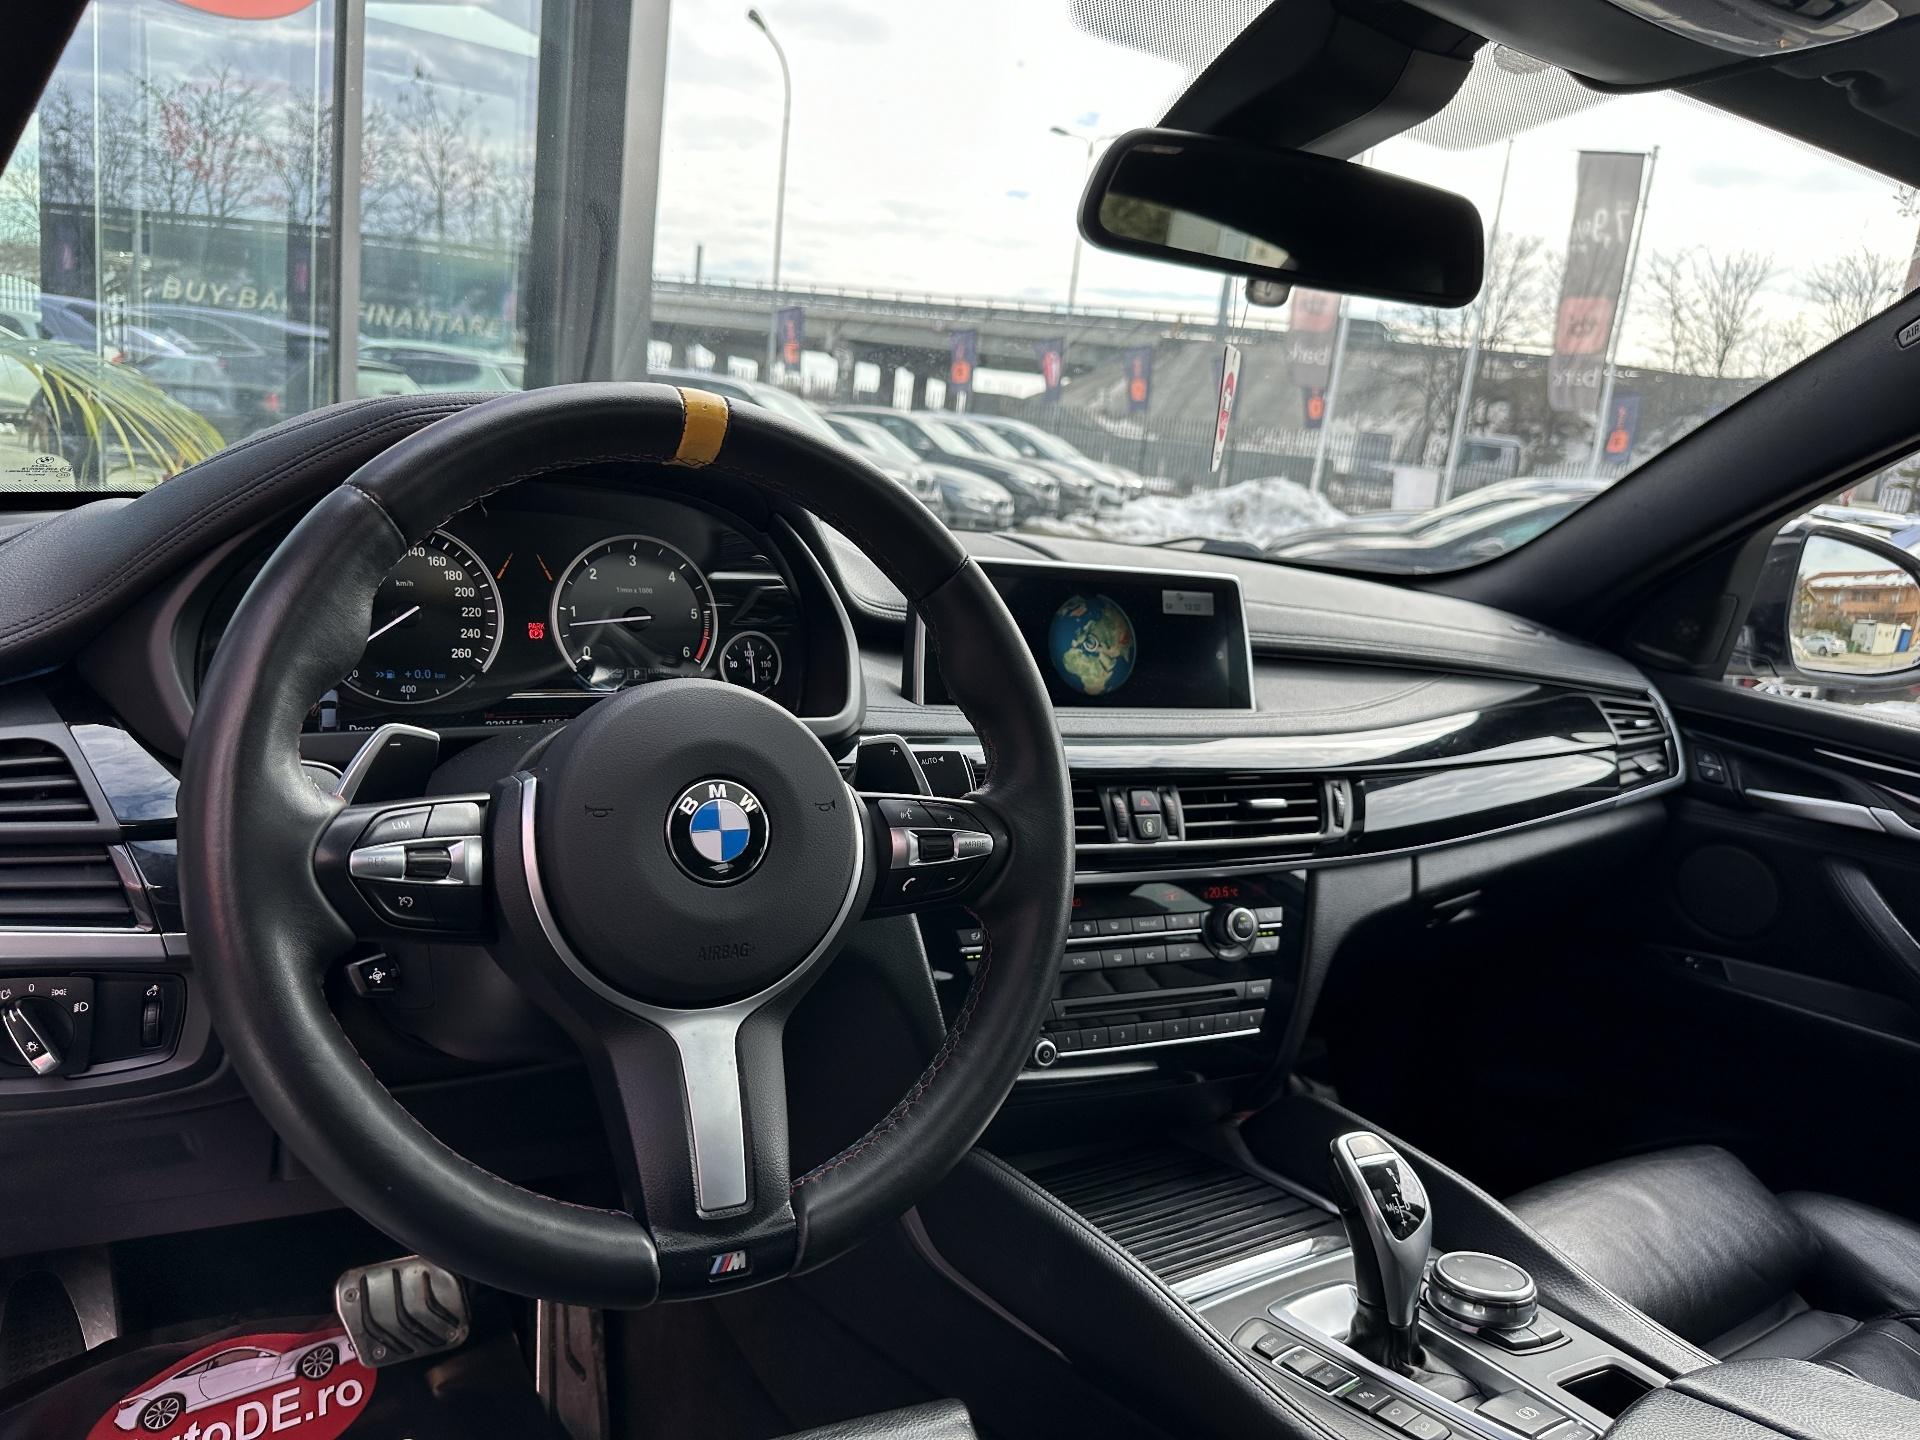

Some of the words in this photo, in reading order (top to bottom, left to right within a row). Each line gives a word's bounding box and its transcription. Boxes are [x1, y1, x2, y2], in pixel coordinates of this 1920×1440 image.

[427, 556, 447, 567] 160
[629, 555, 637, 567] 3
[444, 570, 463, 581] 180
[589, 568, 597, 580] 2
[668, 571, 676, 583] 4
[395, 579, 414, 587] km/h
[454, 587, 475, 598] 200
[461, 607, 482, 618] 220
[570, 606, 577, 617] 1
[690, 609, 698, 620] 5
[460, 628, 481, 639] 240
[451, 648, 472, 659] 260
[682, 646, 690, 658] 6
[400, 685, 417, 693] 400
[921, 757, 938, 765] AUTO
[679, 784, 758, 815] BMW
[391, 820, 411, 830] LIM
[696, 942, 749, 960] AIRBAG
[28, 984, 35, 993] 0
